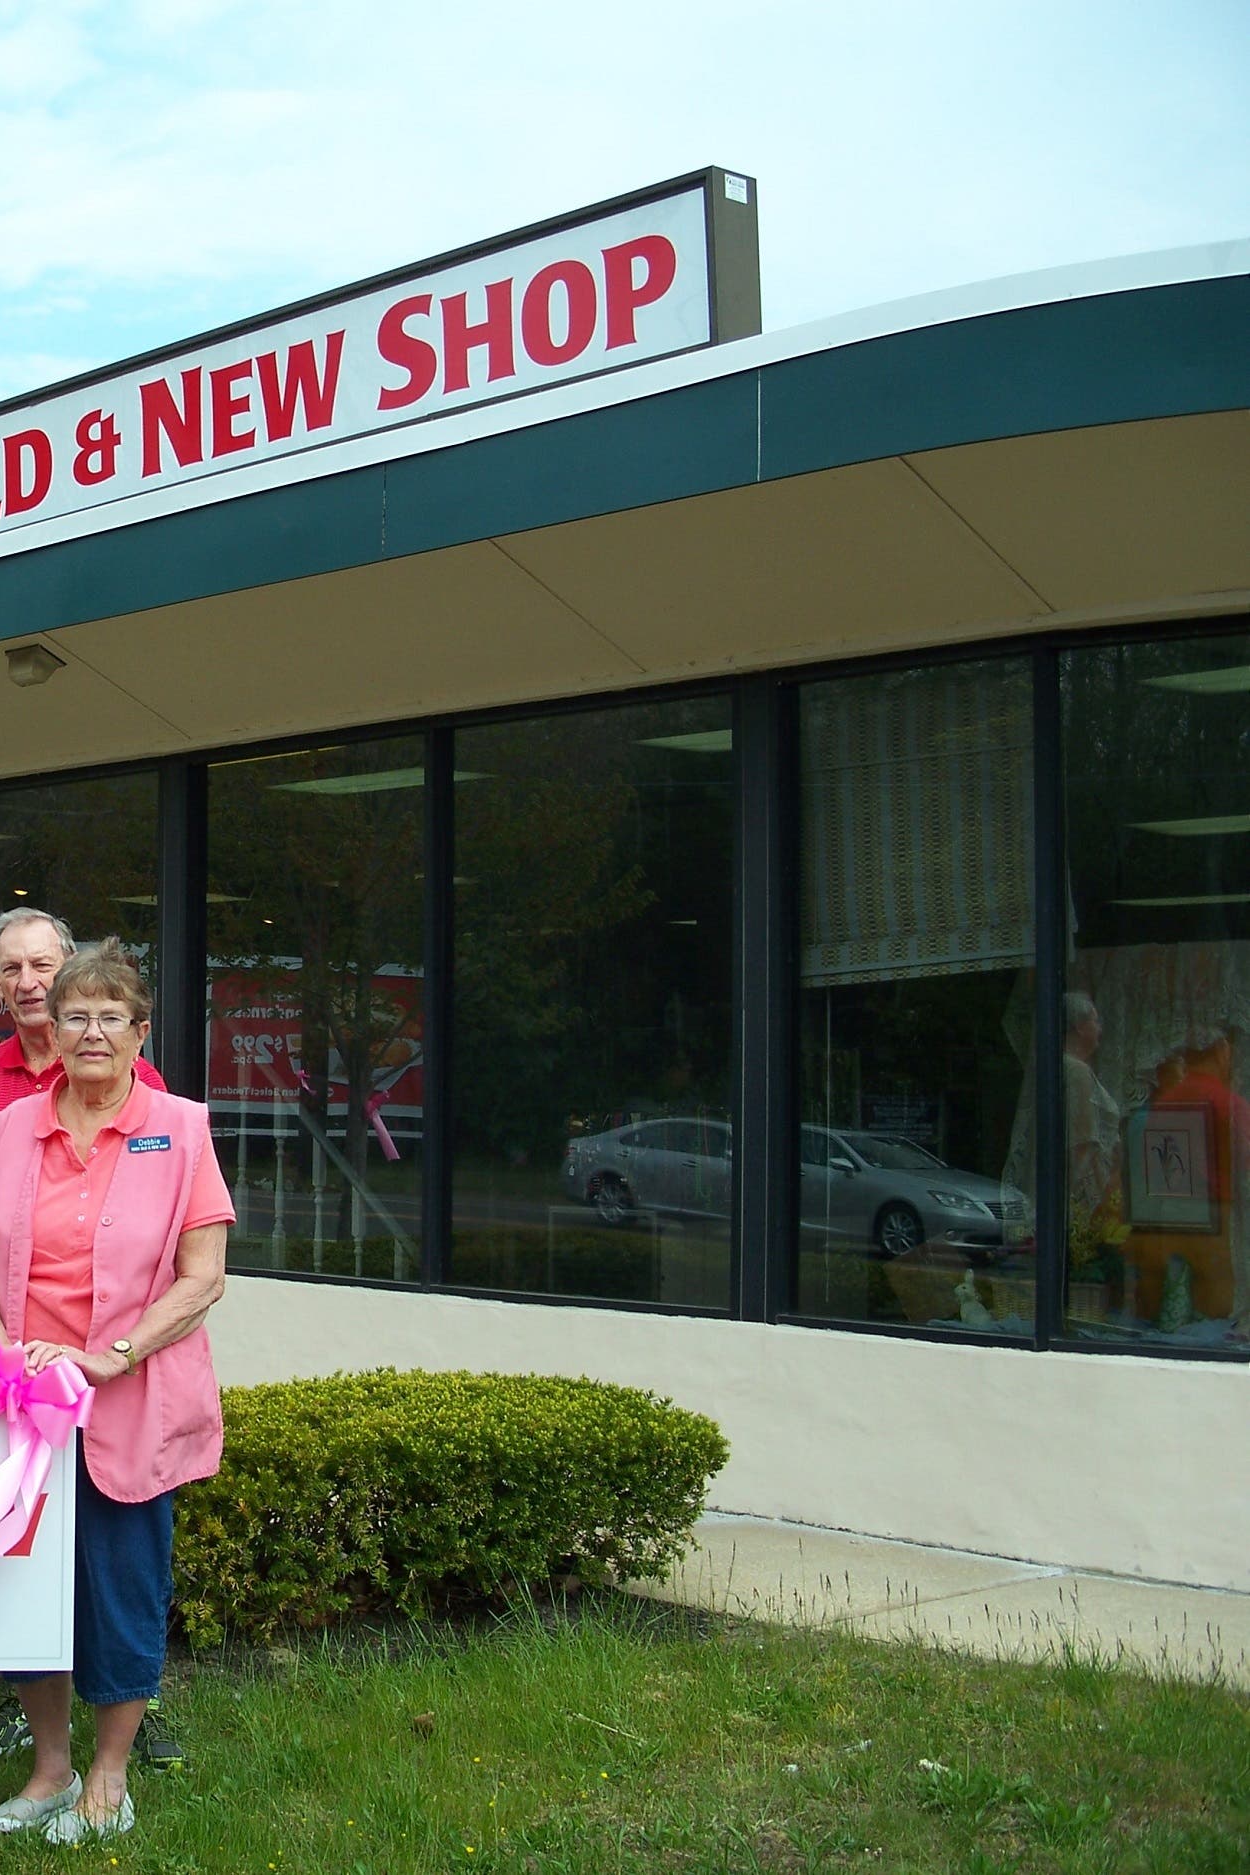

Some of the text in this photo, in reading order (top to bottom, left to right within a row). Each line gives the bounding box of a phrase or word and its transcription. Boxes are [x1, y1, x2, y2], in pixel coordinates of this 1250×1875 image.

[72, 408, 121, 487] &
[139, 329, 345, 479] NEW
[377, 234, 676, 410] SHOP
